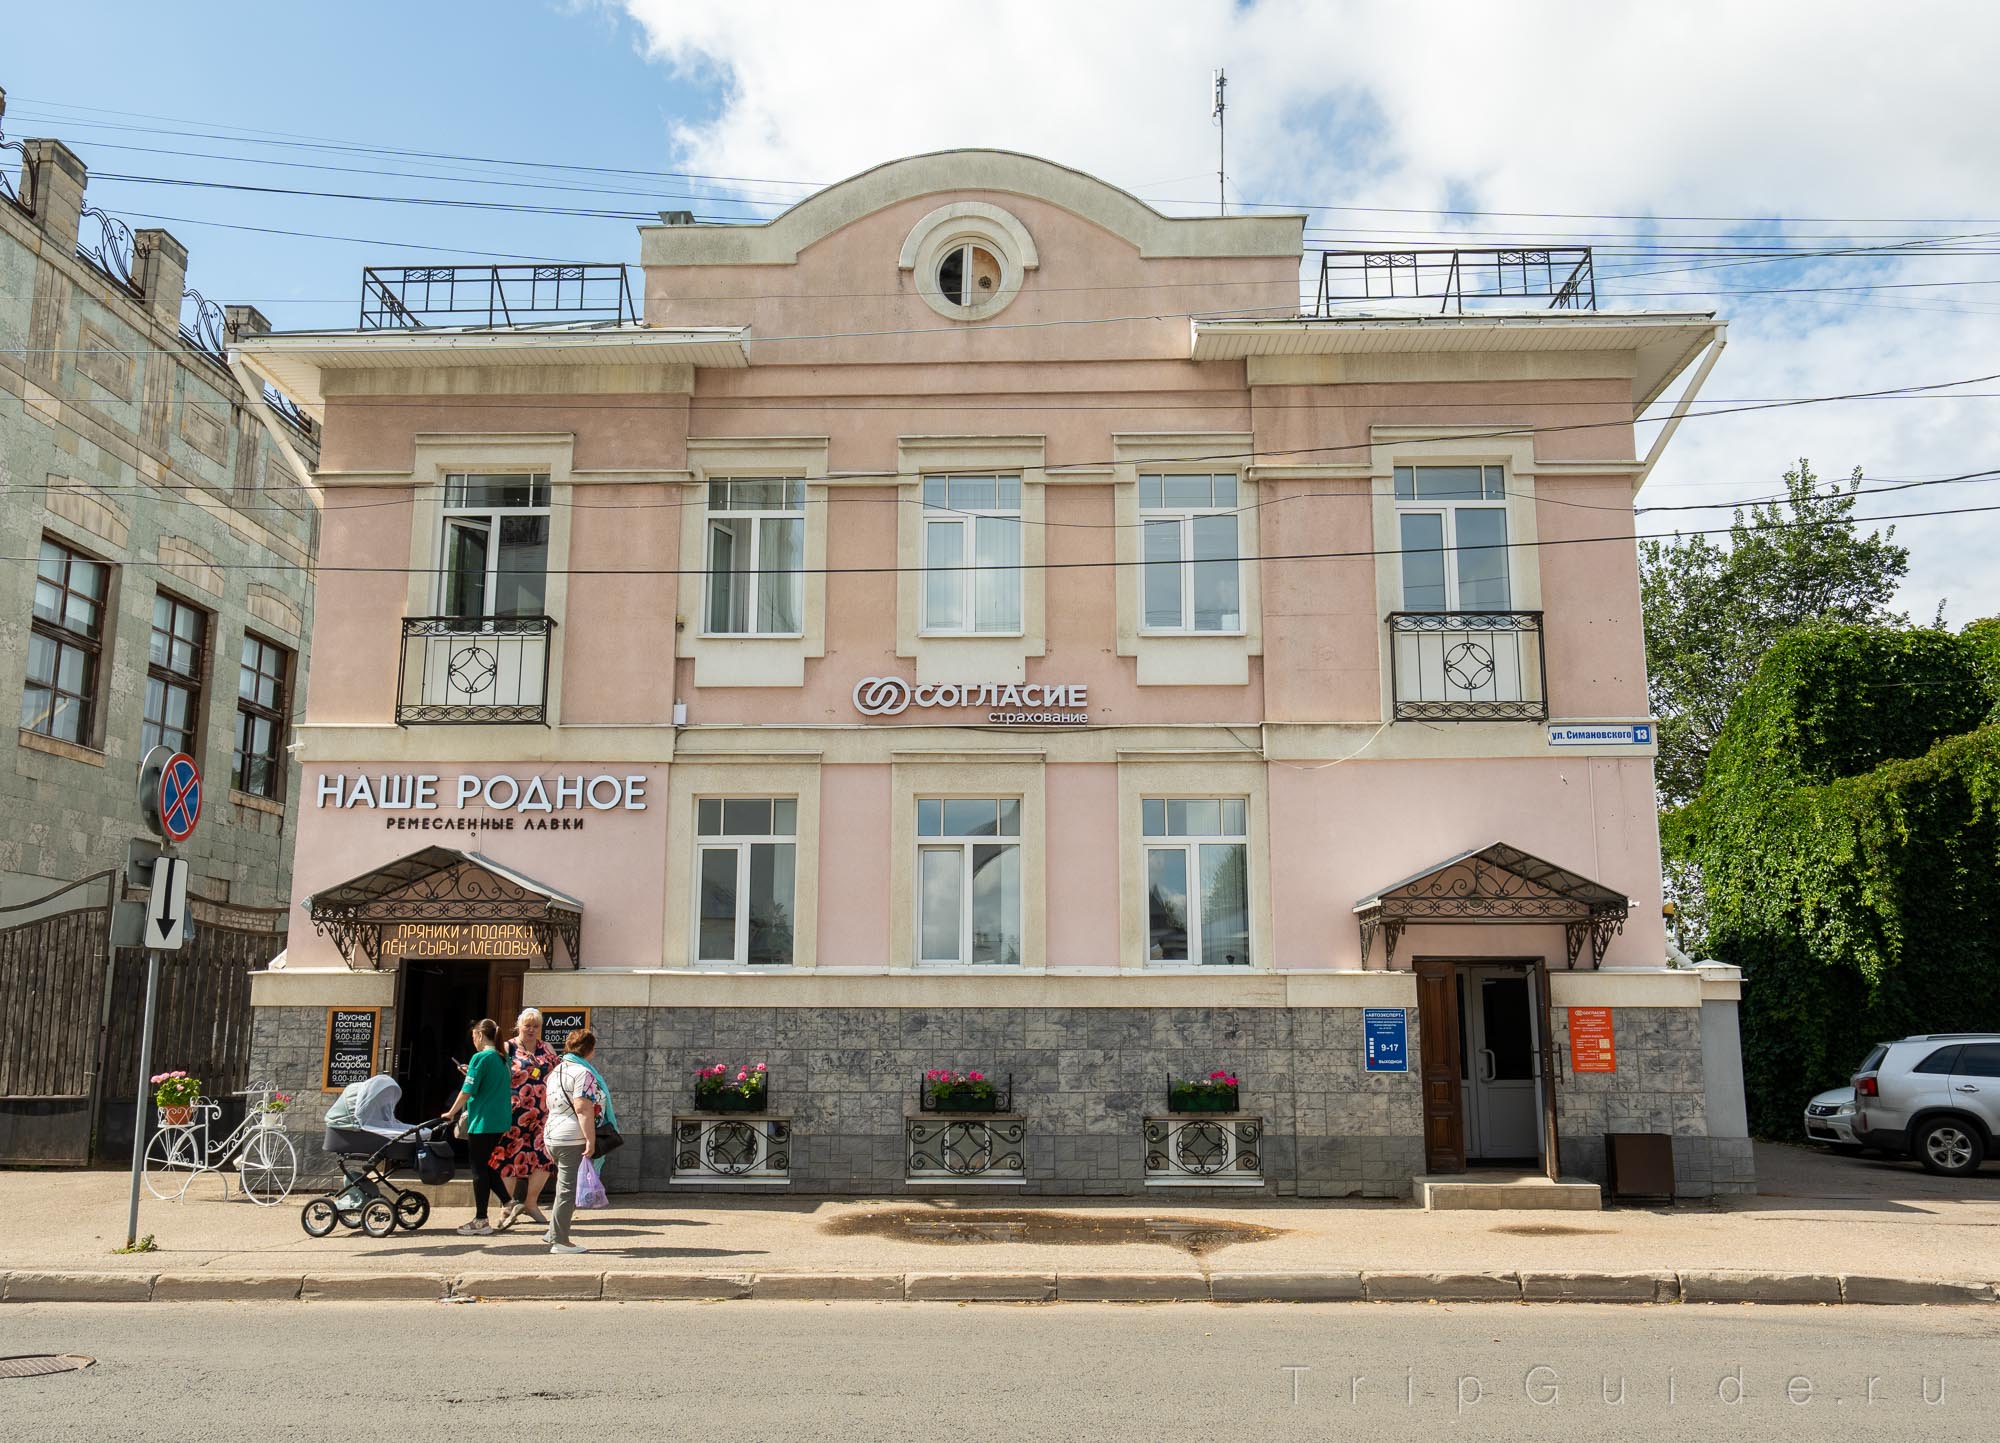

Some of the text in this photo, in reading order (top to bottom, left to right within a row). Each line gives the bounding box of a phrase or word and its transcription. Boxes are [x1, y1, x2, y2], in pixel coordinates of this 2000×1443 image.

[914, 684, 1088, 708] СОГЛАСИЕ
[988, 711, 1089, 725] страхование
[1552, 729, 1648, 740] ул. Симановского 13
[317, 773, 648, 813] НАШЕ РОДНОЕ
[386, 817, 585, 831] РЕМЕСЛЕННЫЕ ЛАВКИ
[398, 924, 460, 940] ПРЯНИКИ
[471, 924, 534, 940] ПОДАРКИ
[418, 940, 459, 956] СЫРЫ
[338, 1012, 370, 1020] Вкусный
[546, 1016, 582, 1026] ЛенОК
[1381, 1044, 1398, 1052] 9-17
[335, 1052, 367, 1062] Сырная
[330, 1060, 371, 1069] кладовка
